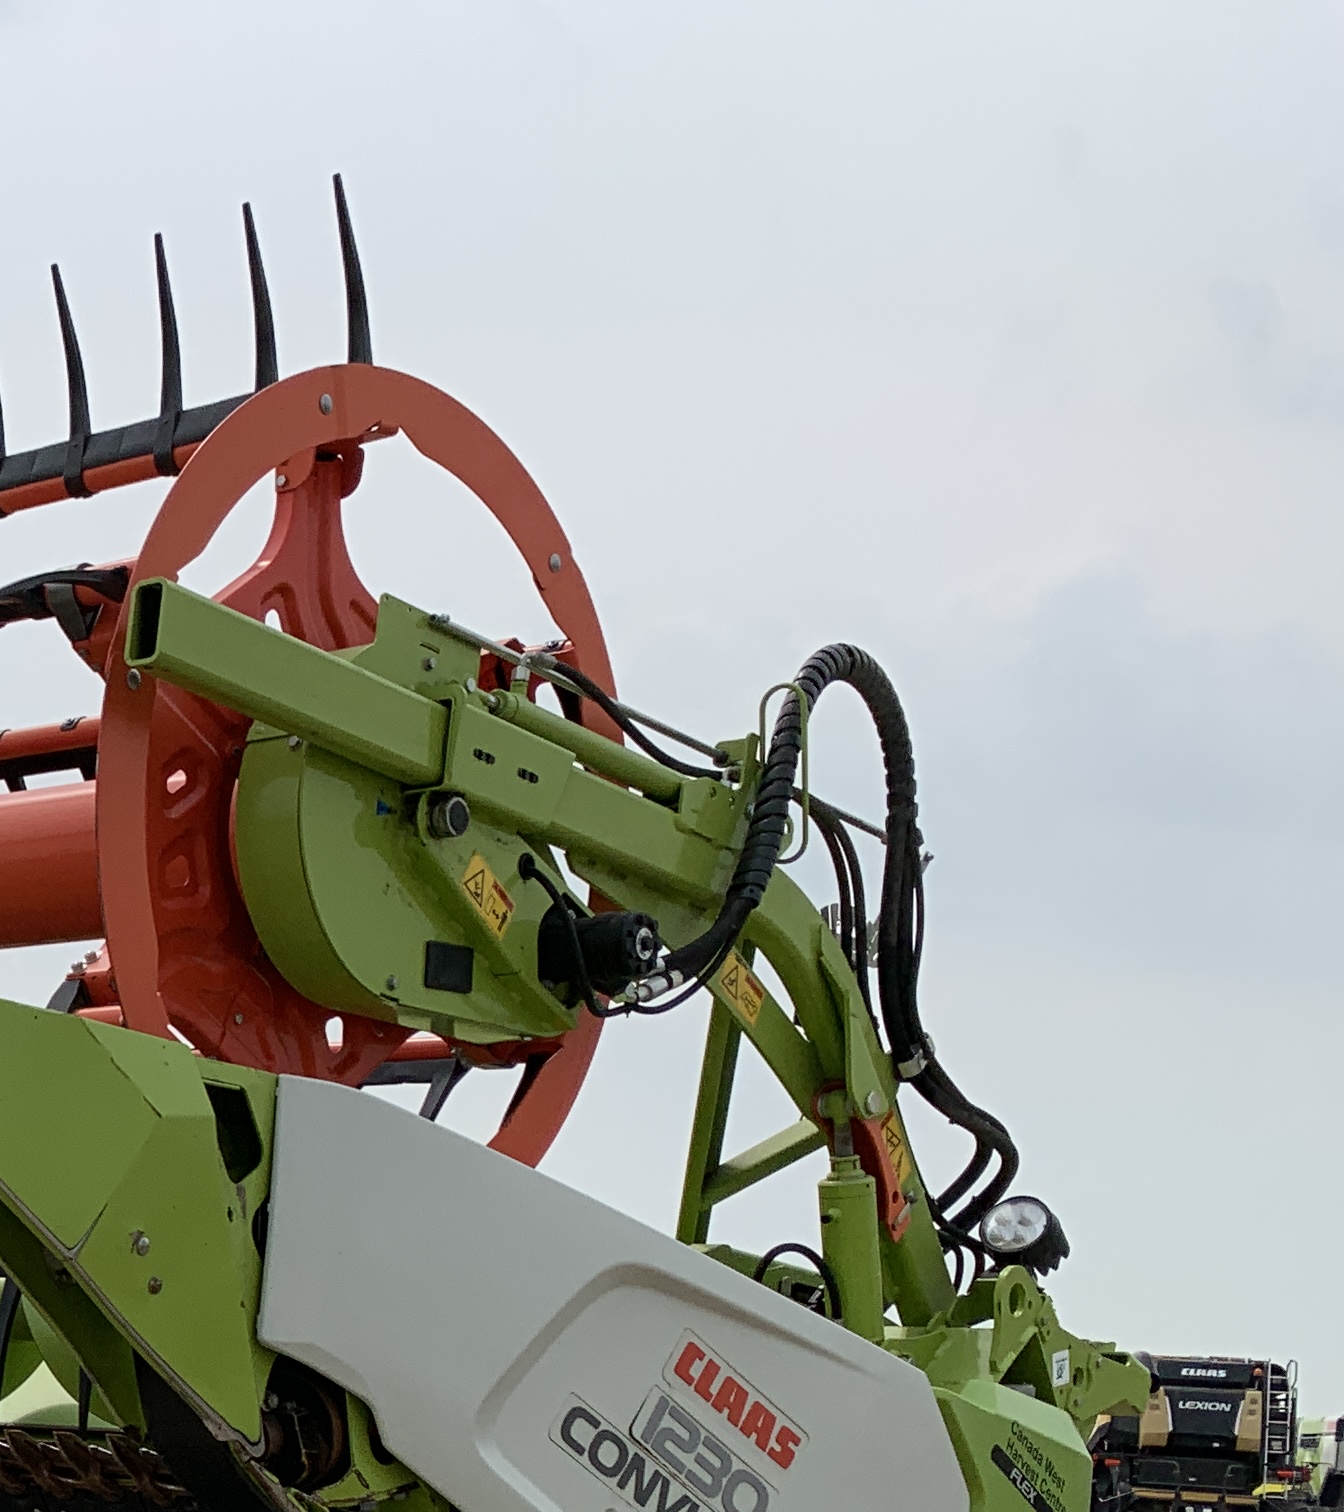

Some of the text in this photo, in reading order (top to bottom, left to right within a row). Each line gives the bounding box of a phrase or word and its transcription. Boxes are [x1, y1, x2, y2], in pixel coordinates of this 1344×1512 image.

[1180, 1367, 1227, 1378] CLAAS
[673, 1341, 802, 1470] CLAAS
[1178, 1400, 1232, 1412] LEXION
[1006, 1437, 1040, 1486] Harvest
[1011, 1421, 1066, 1494] Canada West
[1010, 1467, 1038, 1504] FLEX
